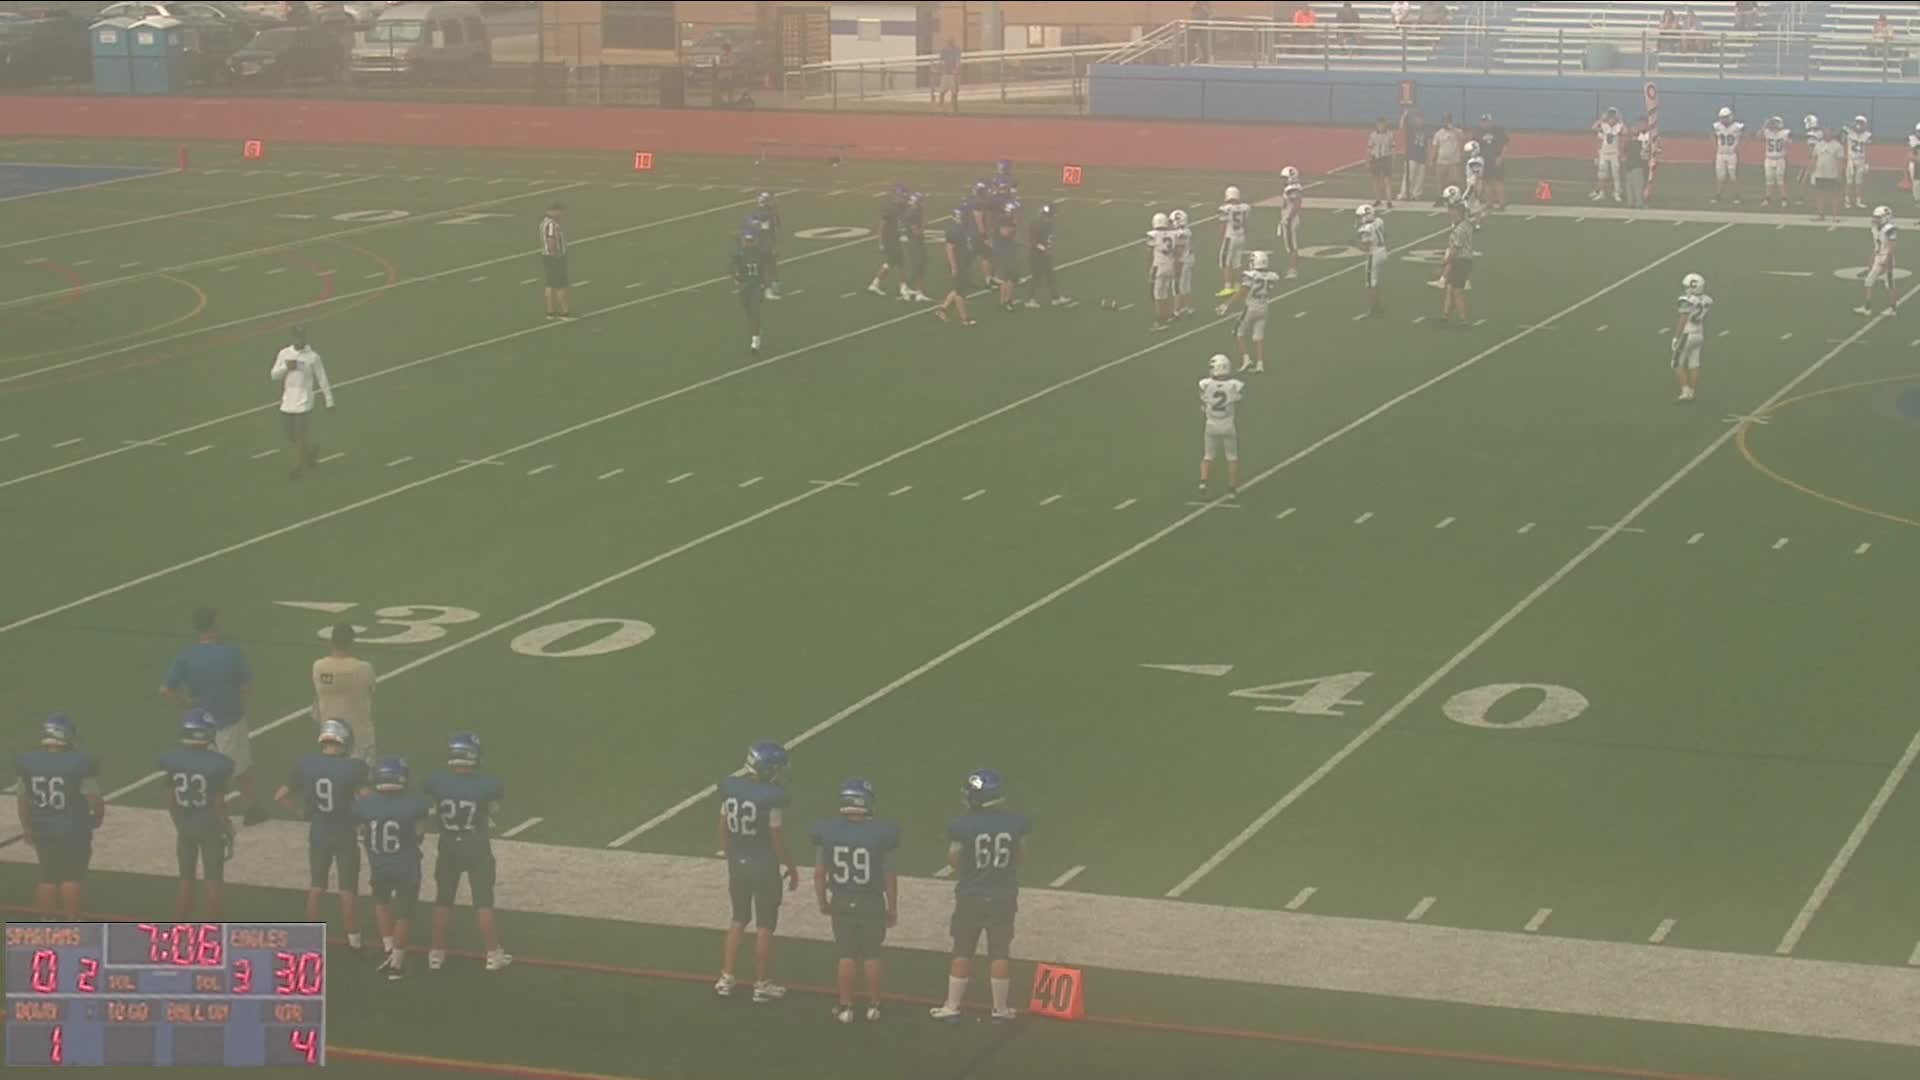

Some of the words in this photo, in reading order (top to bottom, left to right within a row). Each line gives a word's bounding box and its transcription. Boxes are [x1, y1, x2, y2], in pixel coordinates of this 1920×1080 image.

[1211, 390, 1228, 412] 2
[31, 776, 65, 810] 56
[172, 772, 207, 807] 23
[315, 778, 334, 812] 9
[439, 799, 478, 831] 27
[725, 797, 757, 835] 82
[369, 819, 401, 855] 16
[975, 832, 1012, 869] 66
[832, 846, 871, 885] 59
[1034, 969, 1074, 1012] 40
